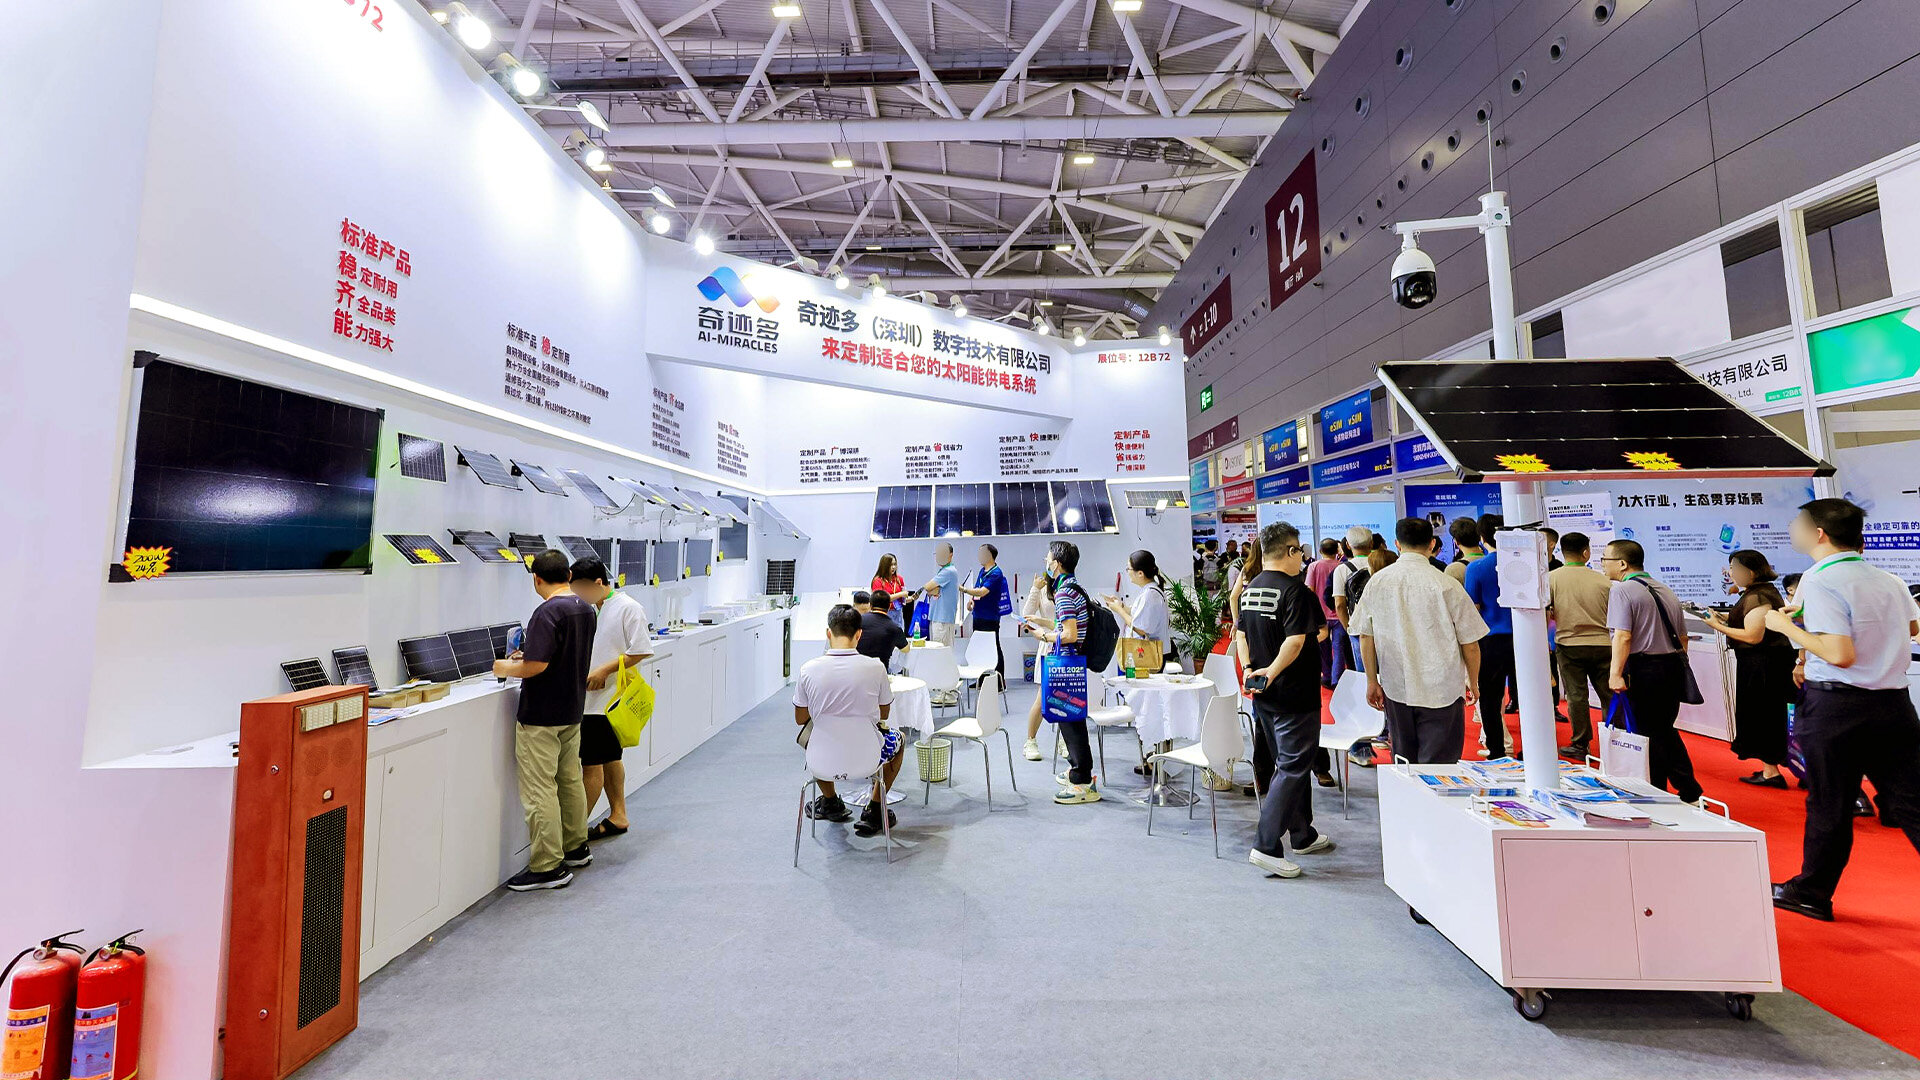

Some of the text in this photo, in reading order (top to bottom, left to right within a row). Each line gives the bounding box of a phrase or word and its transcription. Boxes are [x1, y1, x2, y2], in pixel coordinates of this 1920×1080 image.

[341, 217, 411, 277] 标准产品
[1277, 192, 1307, 273] 12
[338, 250, 398, 299] 稳定耐用
[336, 279, 396, 326] 齐全品类
[1204, 302, 1218, 332] 1-10
[333, 307, 394, 352] 能力强大
[507, 321, 537, 349] 标准产品
[698, 306, 779, 341] 奇迹多
[698, 331, 778, 354] AI-MIRACLES
[822, 336, 1037, 395] 来定制适合您的太阳能供电系统
[1739, 388, 1754, 398] Ltd.
[1114, 429, 1150, 440] 定制产品
[1617, 492, 1764, 508] 九大行业，生态贯穿场景
